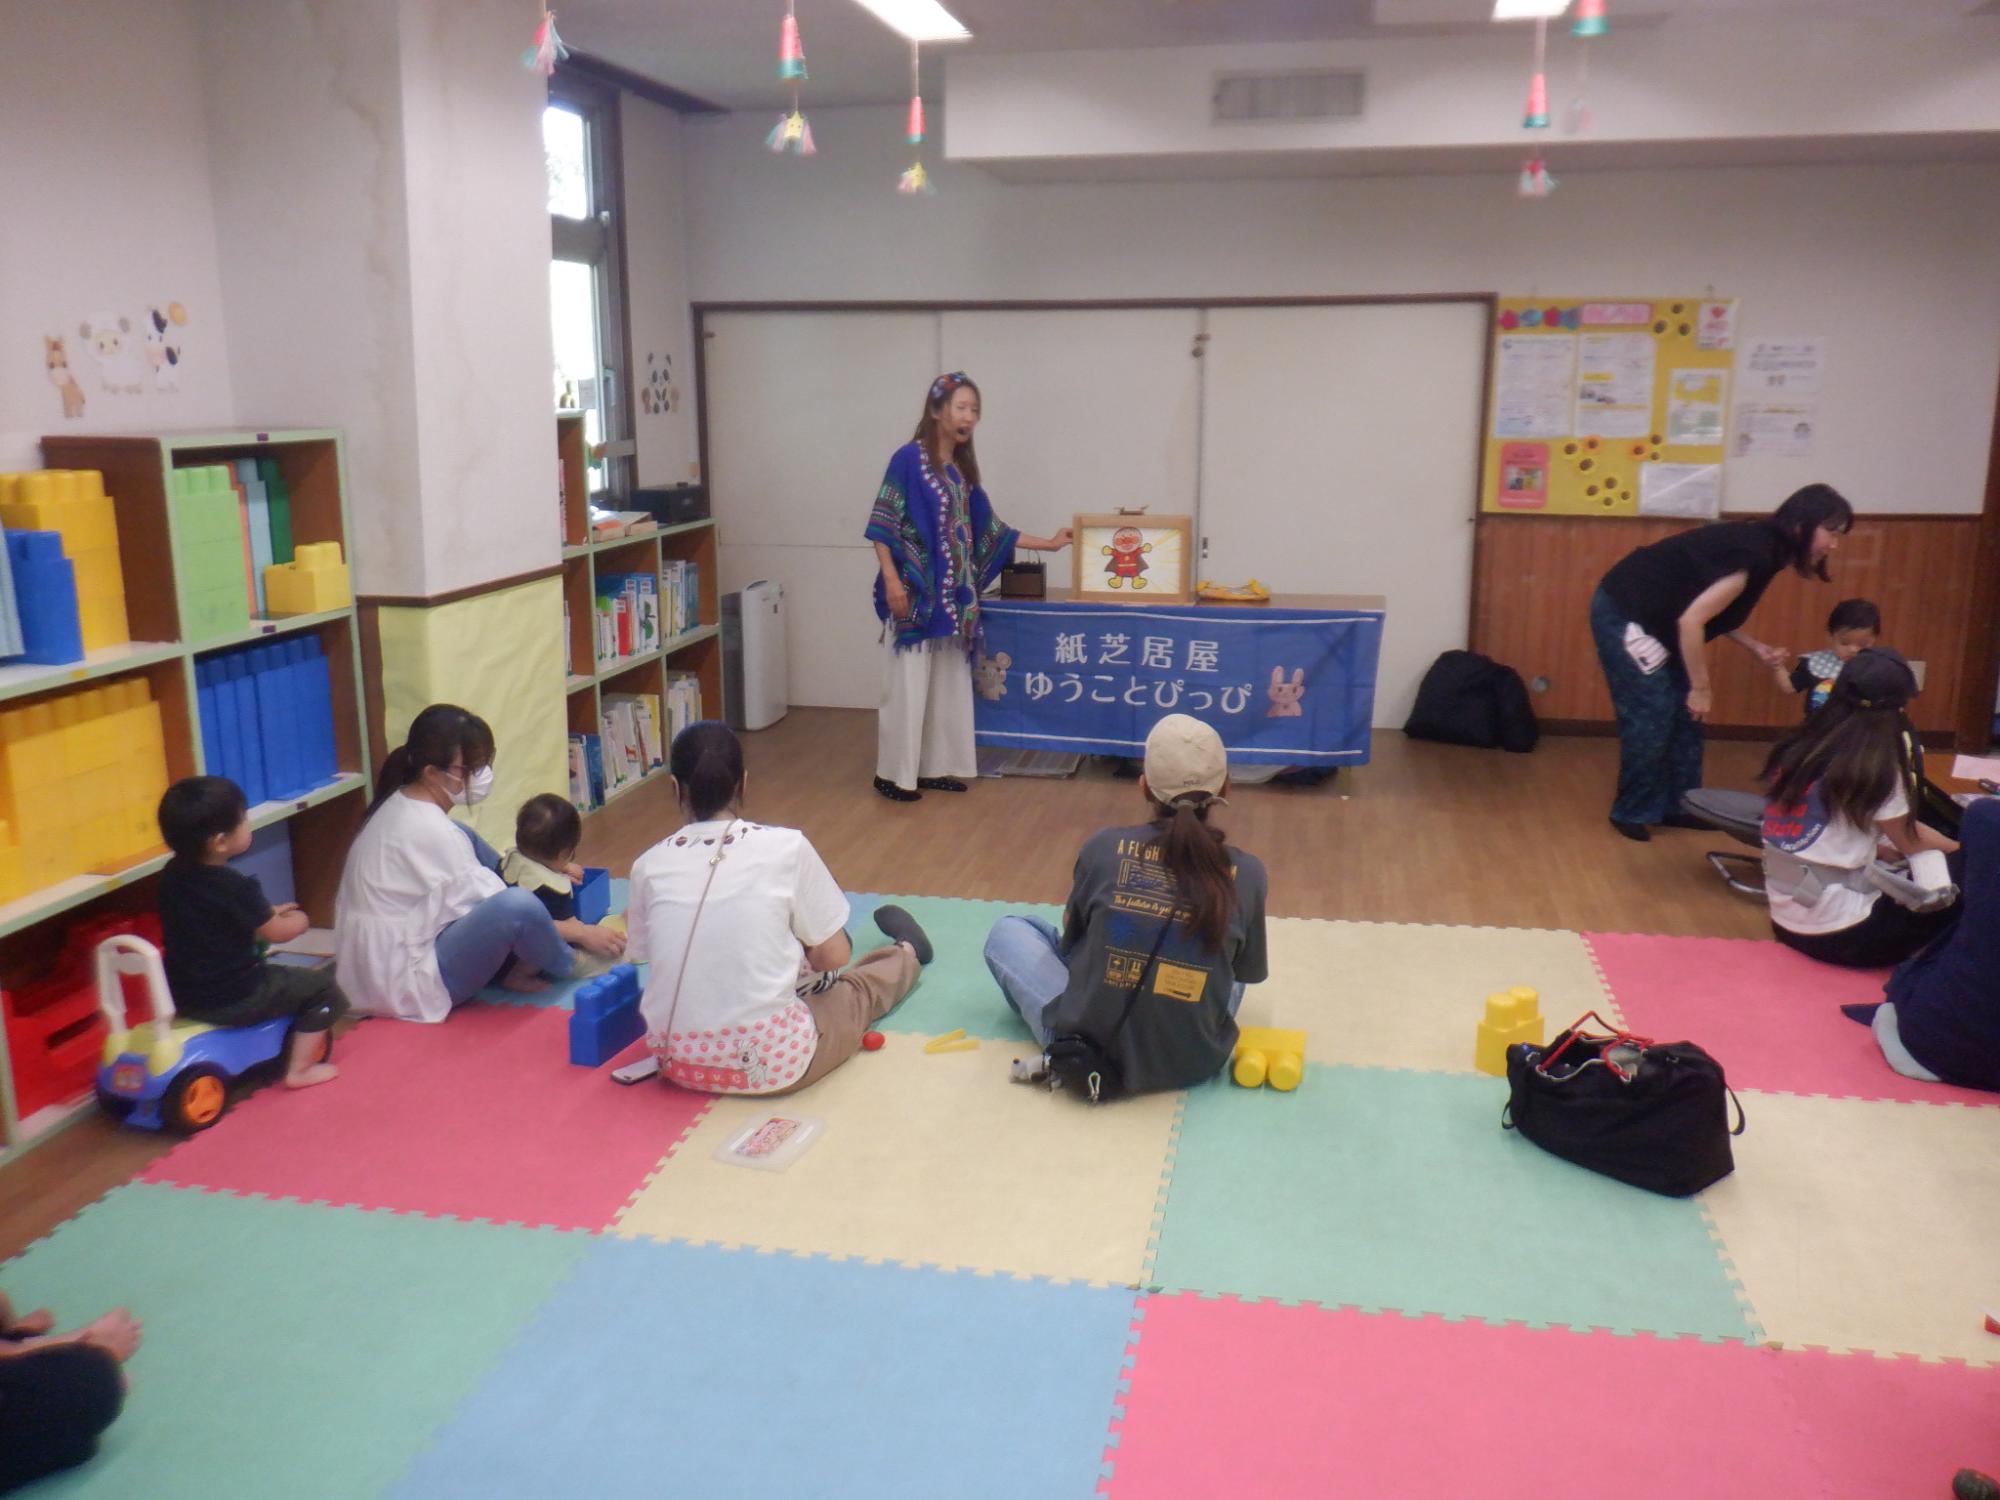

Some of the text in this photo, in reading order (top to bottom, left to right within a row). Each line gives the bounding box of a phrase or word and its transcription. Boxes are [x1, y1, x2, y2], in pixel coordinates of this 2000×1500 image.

[1055, 632, 1219, 672] 紙芝居屋
[1025, 672, 1252, 714] ゆうことぴっぴ
